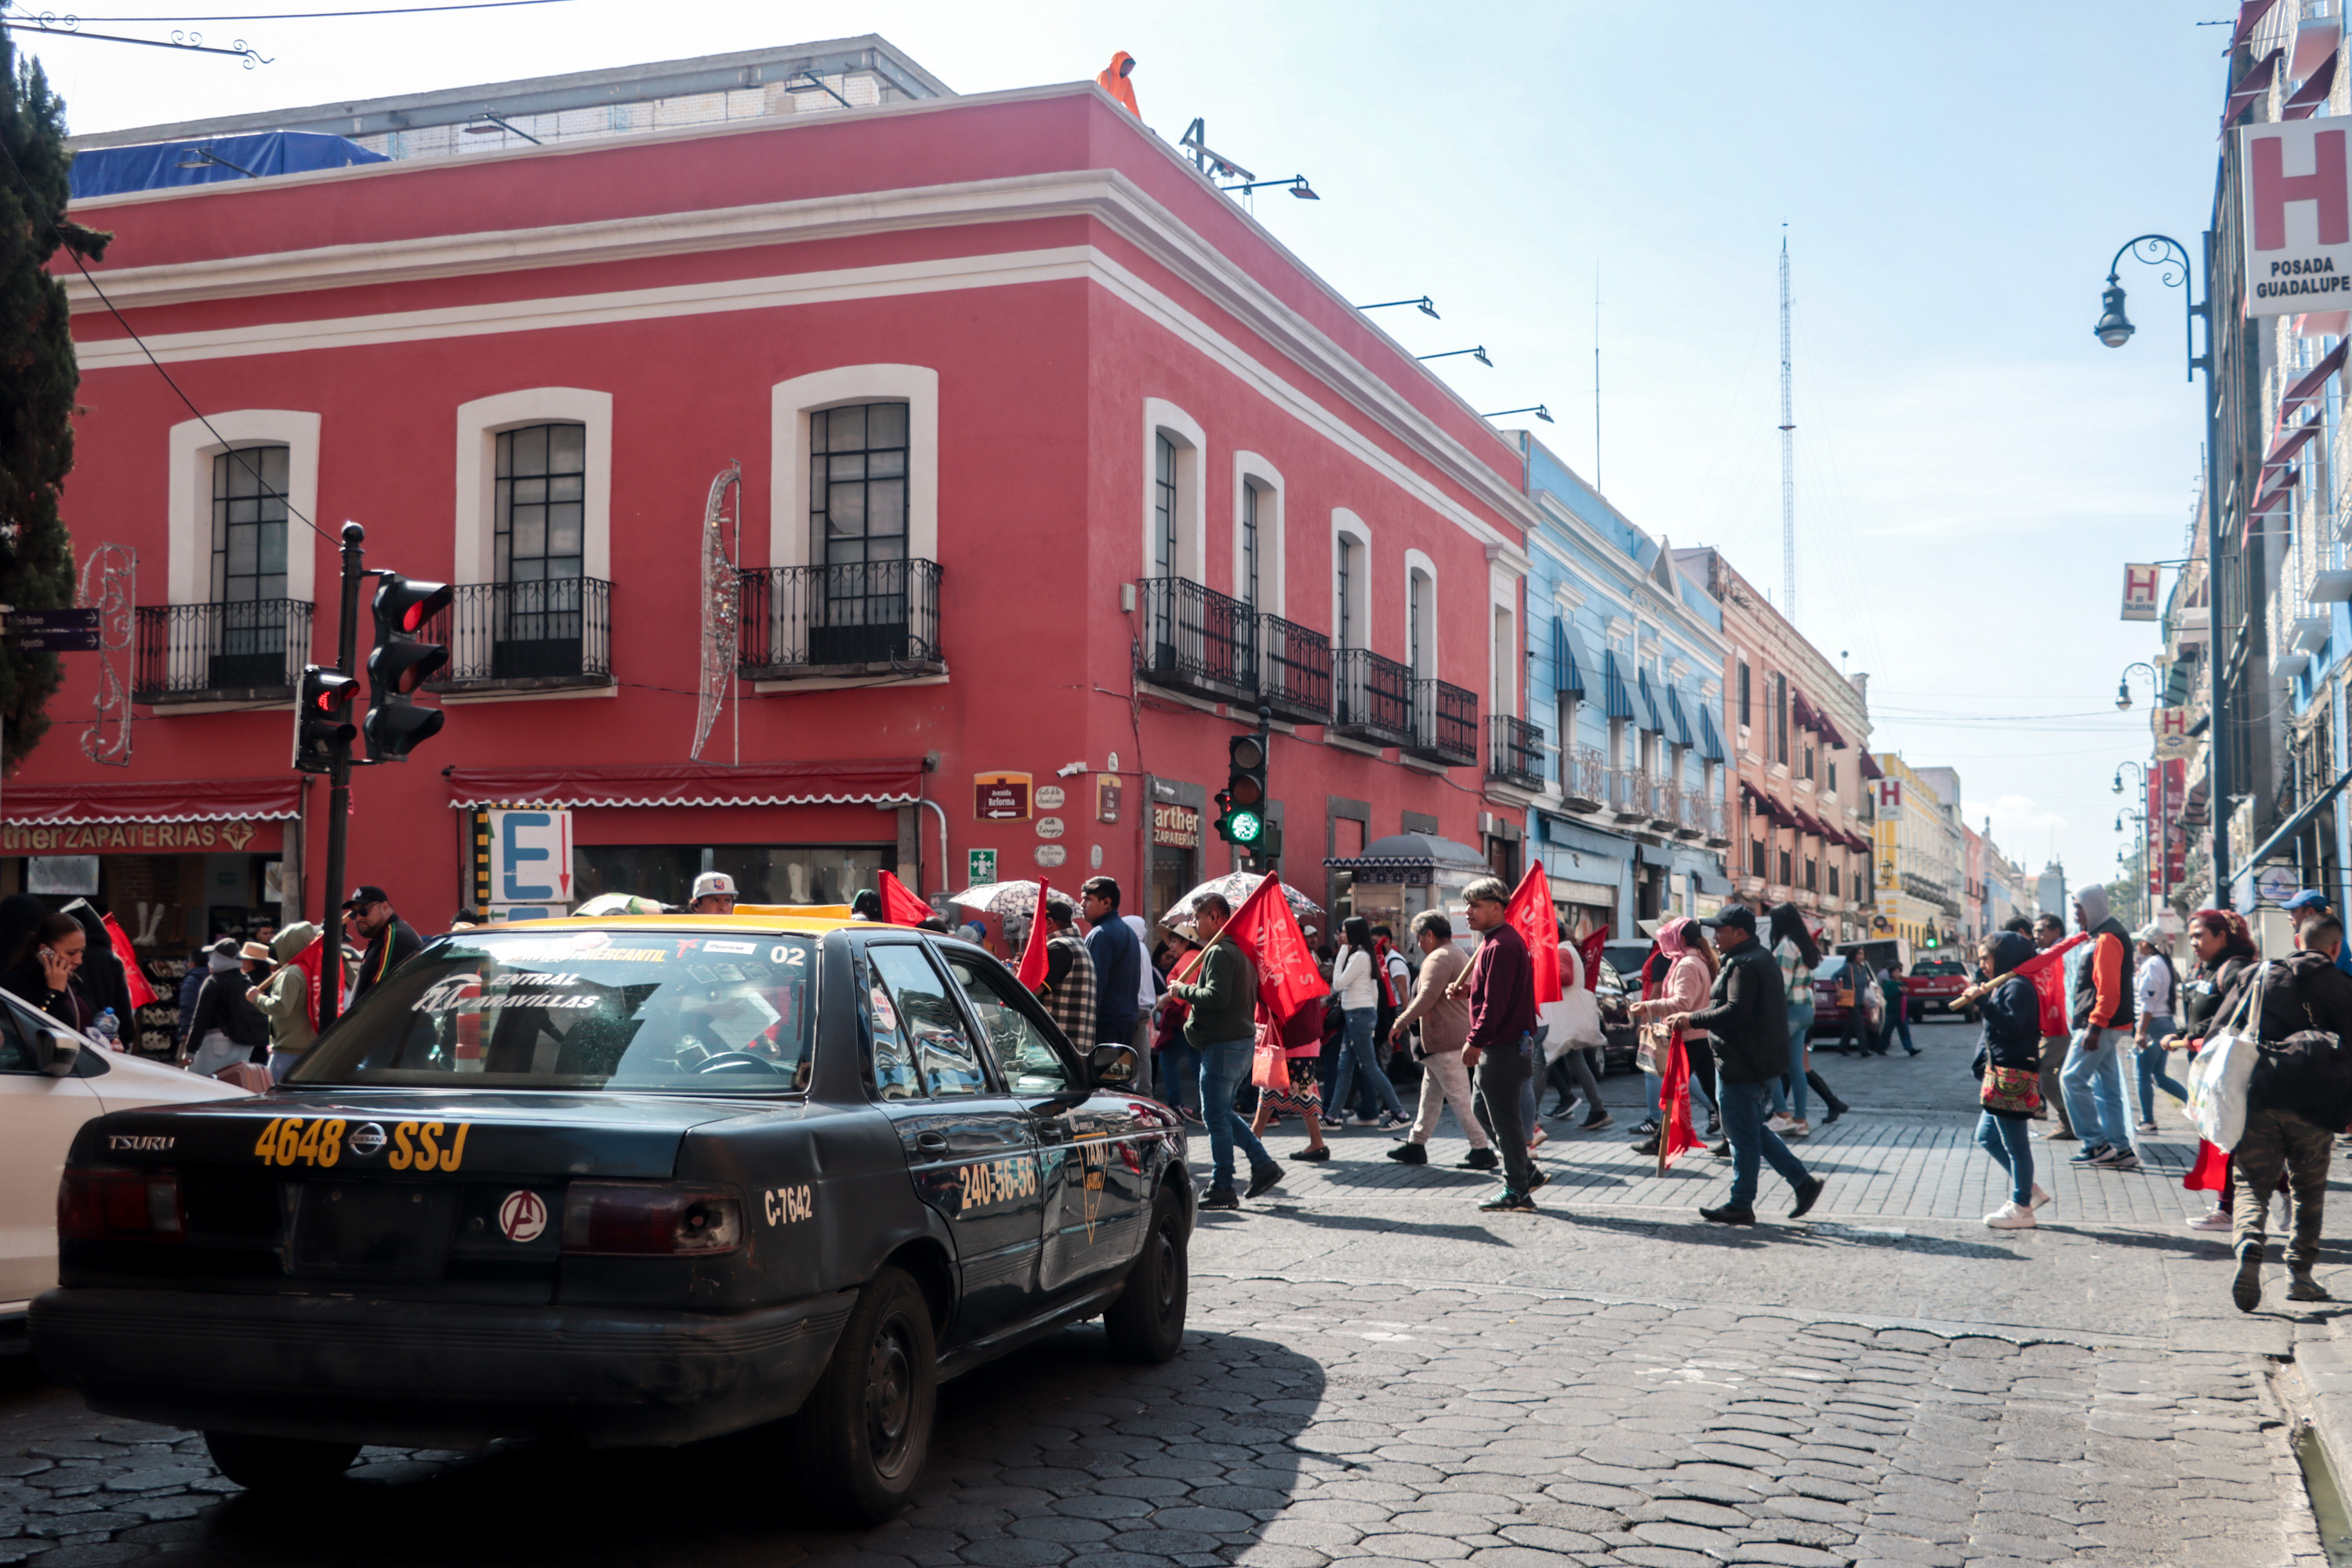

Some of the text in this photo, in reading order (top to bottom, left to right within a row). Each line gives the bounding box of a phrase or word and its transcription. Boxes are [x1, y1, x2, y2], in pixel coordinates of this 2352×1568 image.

[2251, 129, 2350, 251] H
[2271, 257, 2335, 277] POSADA
[2256, 276, 2351, 299] GUADALUPE
[2126, 569, 2156, 601] H
[989, 797, 1016, 807] Reforma
[1881, 781, 1900, 806] H
[1155, 806, 1199, 832] arther
[64, 822, 217, 849] ZAPATERÍAS
[1153, 829, 1200, 848] ZAPATERÍAS
[503, 812, 554, 900] E
[770, 946, 806, 967] 02
[109, 1135, 176, 1151] TSURU
[255, 1117, 470, 1172] 4648 SSJ
[1083, 1140, 1104, 1167] TAXI
[960, 1156, 1036, 1210] 240-56-56
[764, 1185, 812, 1227] C-7642
